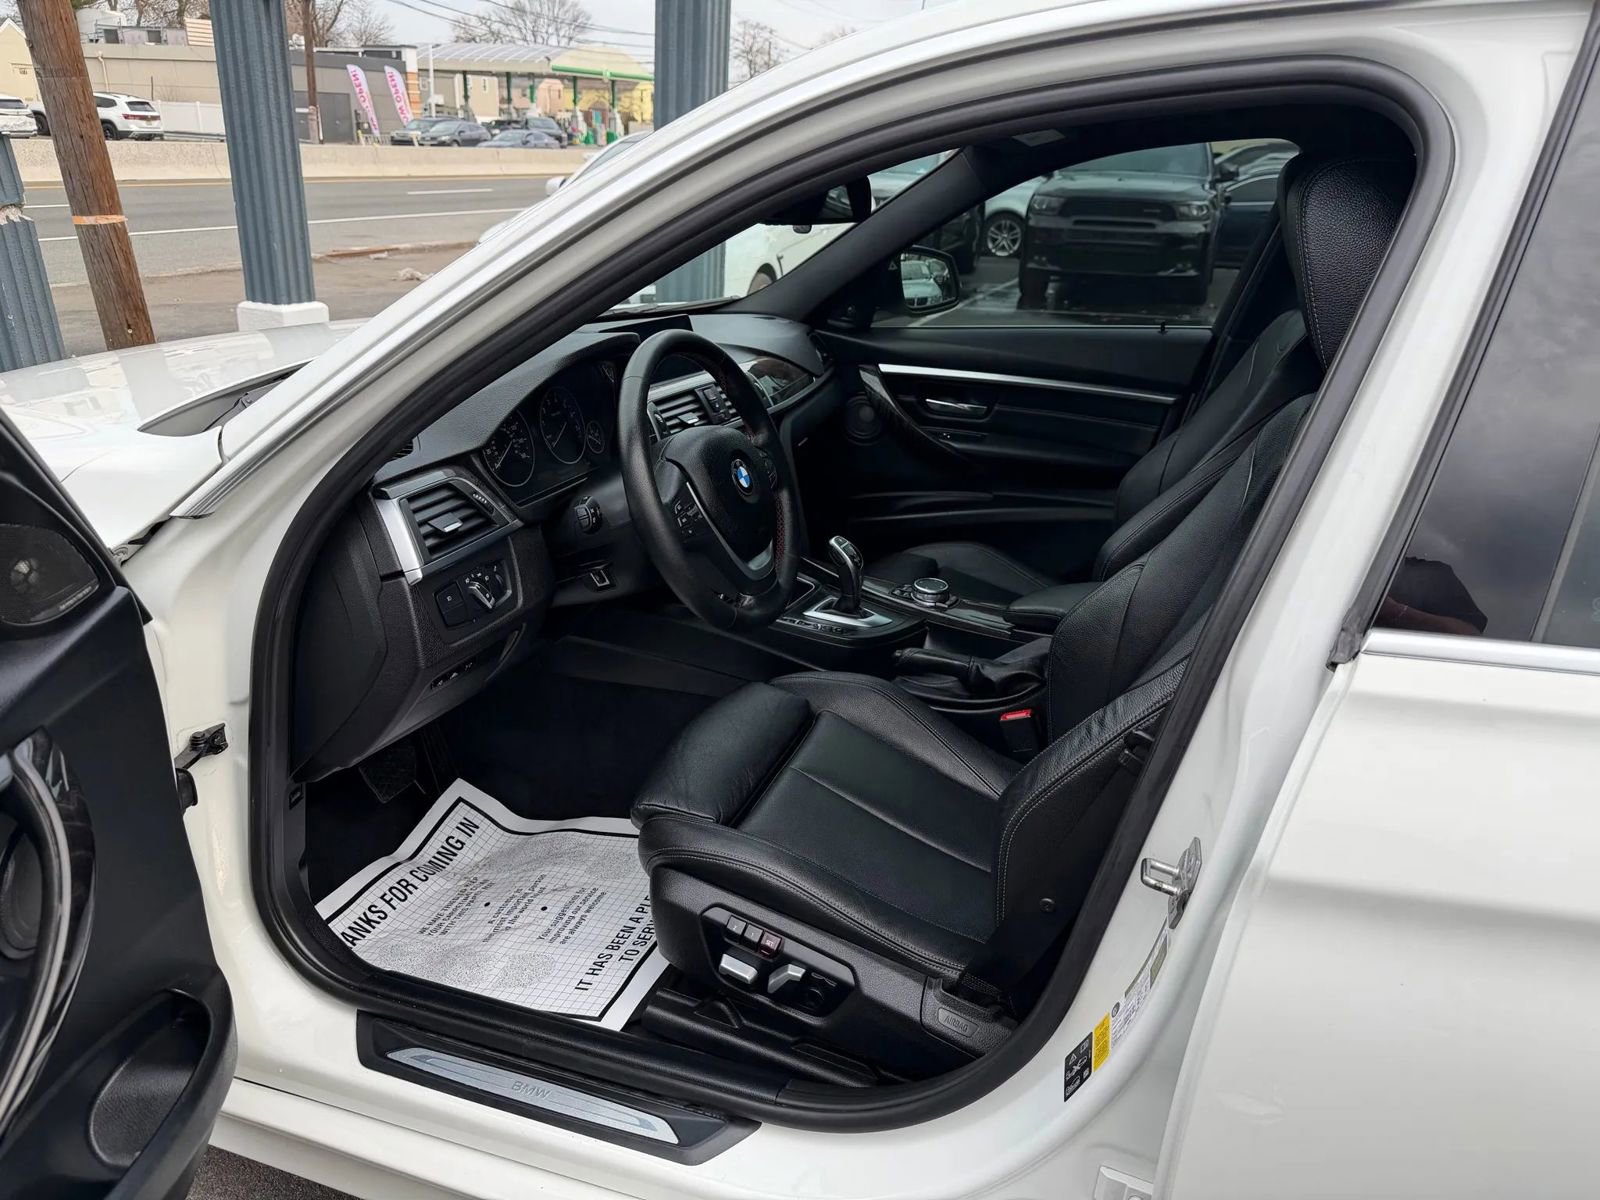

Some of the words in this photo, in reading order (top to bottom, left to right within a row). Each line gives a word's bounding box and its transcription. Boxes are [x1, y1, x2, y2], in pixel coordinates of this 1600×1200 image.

[341, 904, 388, 947] ANKS
[380, 878, 419, 910] FOR
[409, 835, 466, 883] COMING
[455, 817, 480, 838] IN
[426, 912, 444, 925] HAVE
[568, 914, 588, 935] always
[536, 927, 552, 939] Your
[575, 979, 593, 991] IT
[585, 953, 613, 976] HAS
[605, 925, 636, 951] BEEN
[629, 916, 644, 924] A
[618, 949, 640, 962] TO
[511, 1081, 550, 1099] BMW
